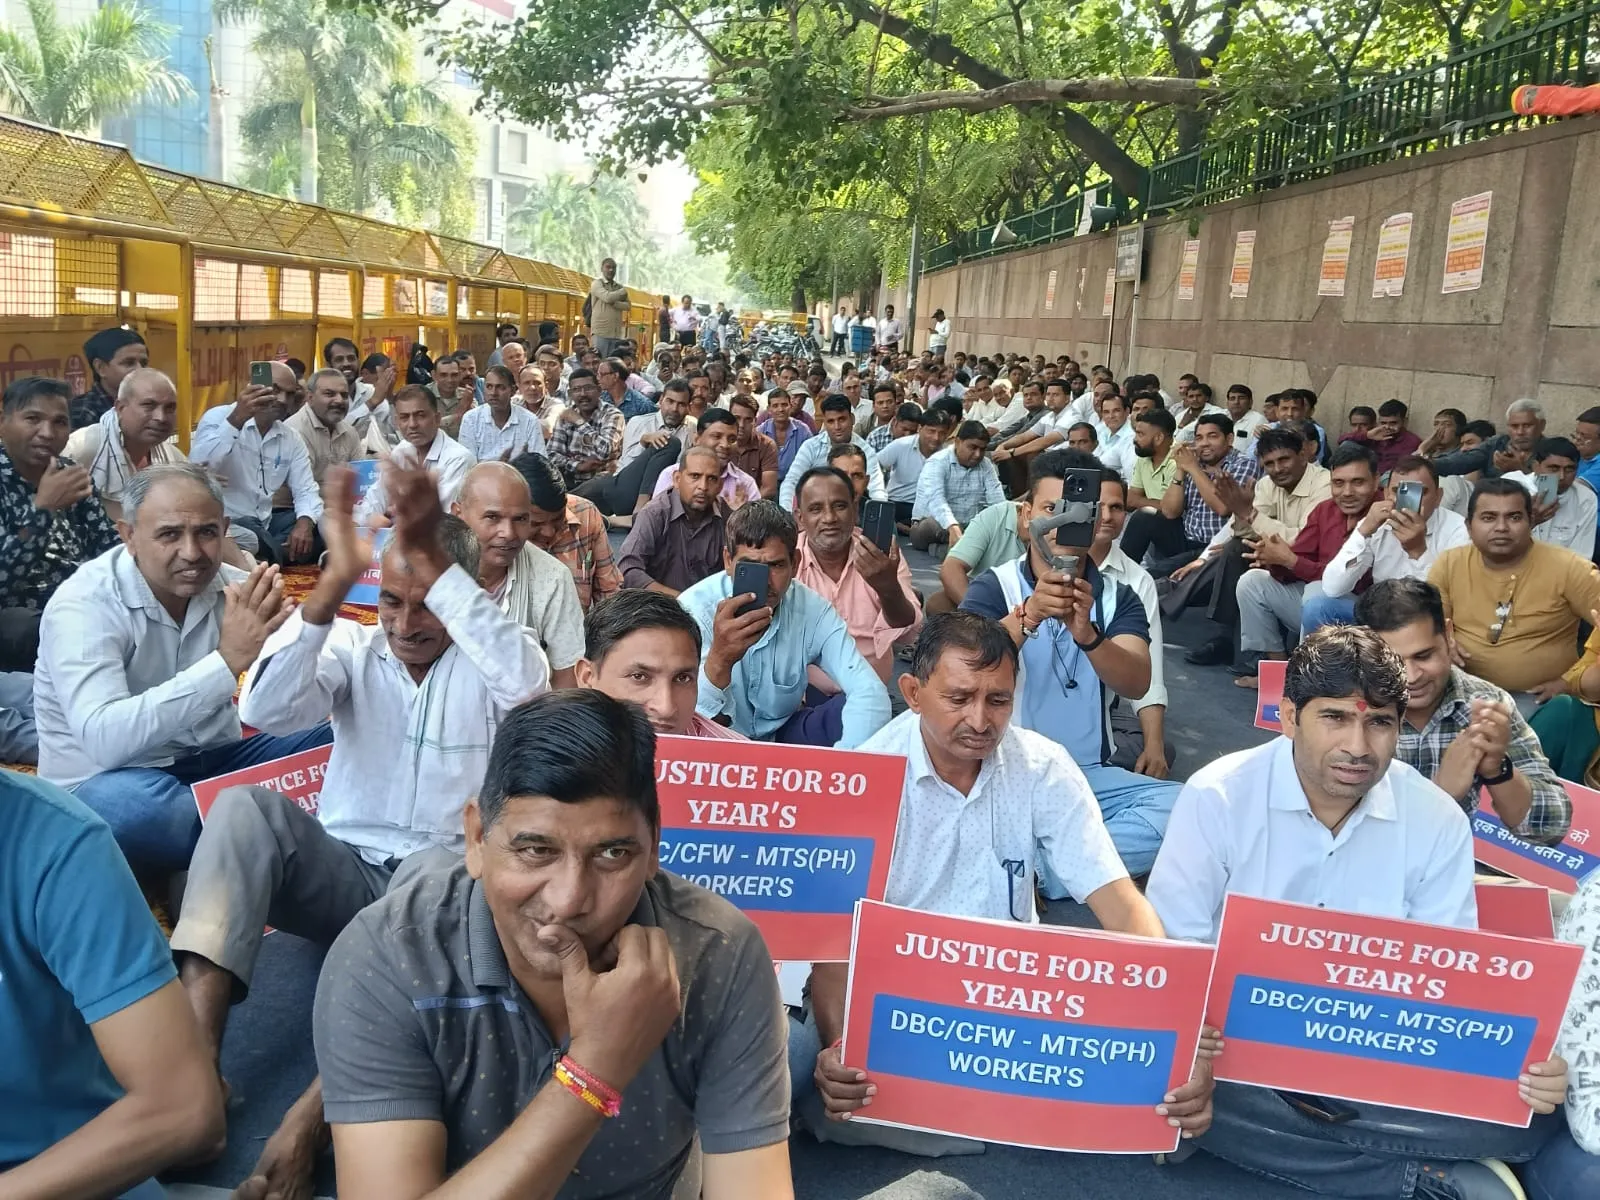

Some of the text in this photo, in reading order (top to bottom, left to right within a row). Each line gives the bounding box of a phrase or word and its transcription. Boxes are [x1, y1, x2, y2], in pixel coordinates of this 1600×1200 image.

[763, 767, 823, 794] FOR
[828, 772, 868, 796] 30
[687, 799, 797, 829] YEAR'S
[1473, 818, 1497, 835] एक
[657, 841, 735, 865] C/CFW
[756, 846, 857, 876] MTS(PH)
[893, 932, 1168, 989] JUSTICE FOR 30
[1260, 922, 1534, 981] JUSTICE FOR 30
[961, 979, 1085, 1018] YEAR'S
[1323, 962, 1447, 1000] YEAR'S
[1250, 987, 1374, 1021] DBC/CFW
[1396, 1010, 1515, 1046] MTS(PH)
[890, 1009, 1016, 1048] DBC/CFW
[1041, 1033, 1155, 1067] MTS(PH)
[1304, 1020, 1438, 1056] WORKER'S
[949, 1050, 1085, 1088] WORKER'S
